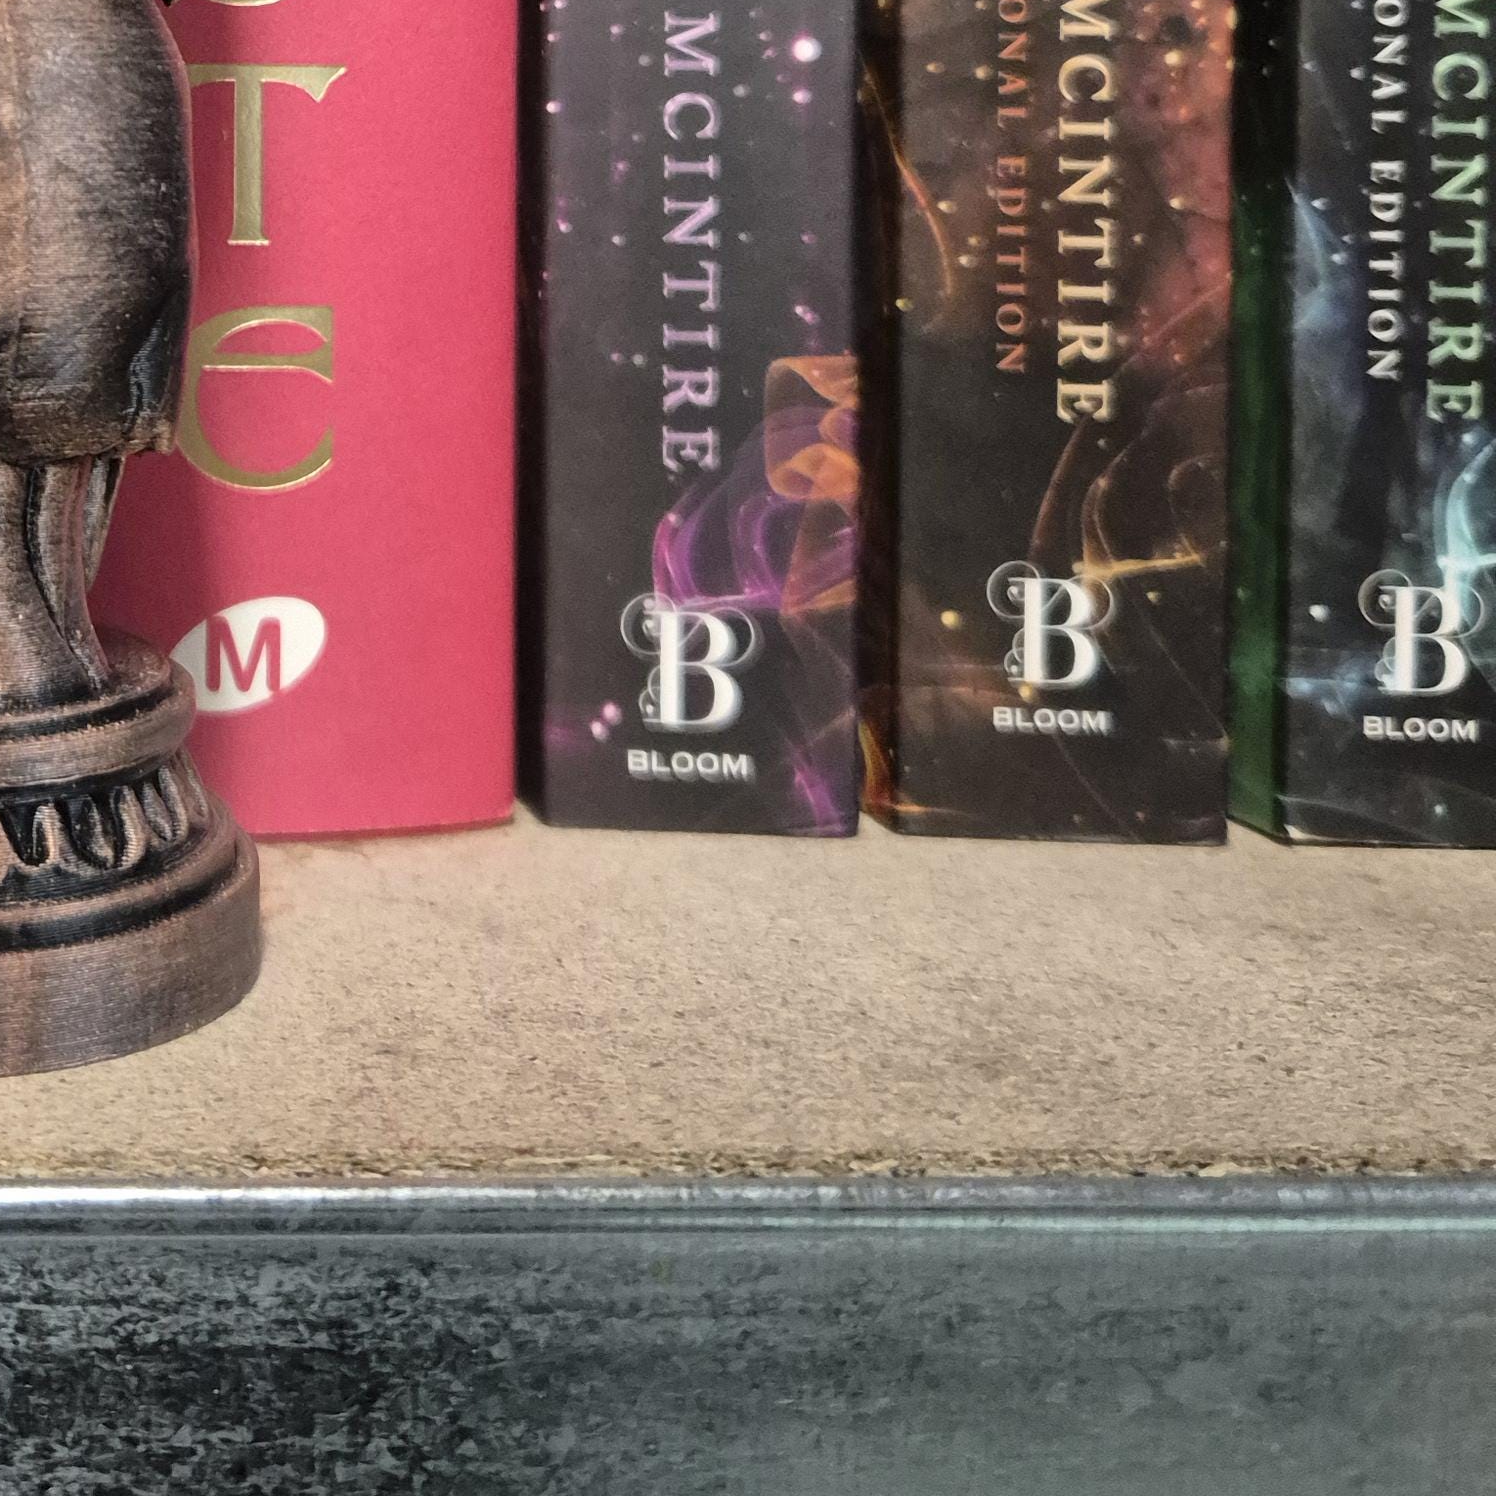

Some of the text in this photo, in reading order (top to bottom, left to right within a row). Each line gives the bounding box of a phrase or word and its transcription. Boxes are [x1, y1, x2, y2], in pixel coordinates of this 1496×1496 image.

[661, 12, 721, 472] MCINTIRE
[995, 154, 1030, 375] EDITION
[1366, 160, 1406, 381] EDITION
[204, 615, 282, 694] M
[992, 706, 1107, 734] BLOOM
[1363, 715, 1479, 744] BLOOM
[627, 749, 753, 781] BLOOM
